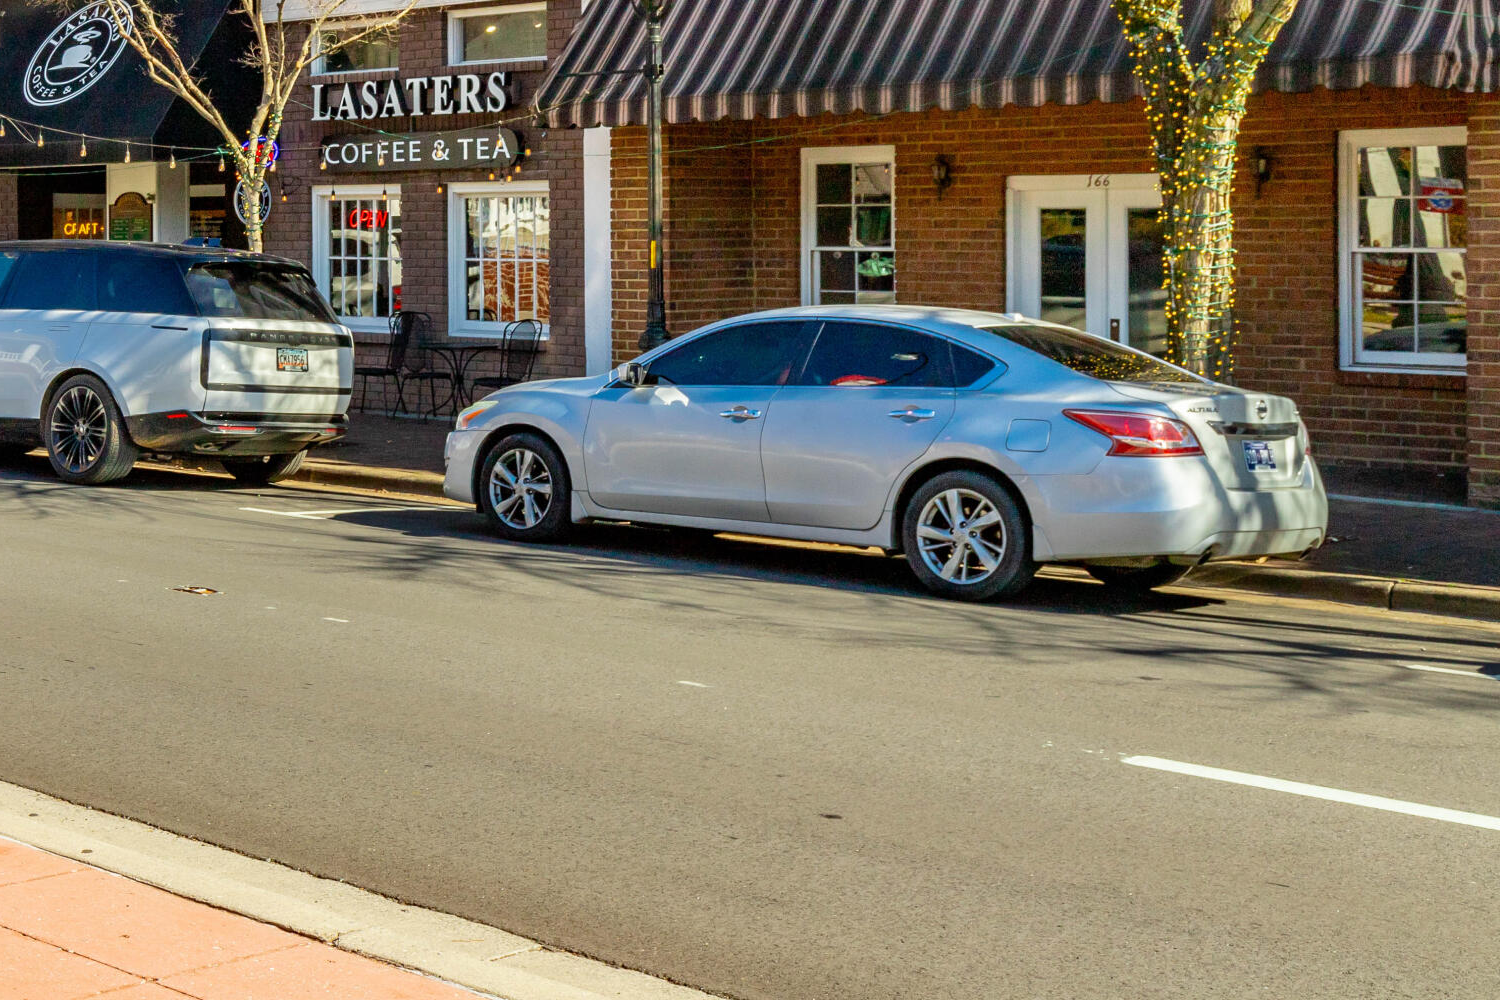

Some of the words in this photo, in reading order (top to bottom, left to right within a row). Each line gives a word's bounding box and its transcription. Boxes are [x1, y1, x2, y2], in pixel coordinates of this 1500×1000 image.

[32, 66, 57, 97] COFFEE
[62, 85, 72, 95] &
[79, 60, 108, 85] TEA
[311, 72, 506, 121] LASATERS
[325, 141, 421, 164] COFFEE
[431, 139, 449, 161] &
[457, 137, 511, 161] TEA
[1087, 174, 1110, 188] 166
[350, 208, 388, 229] OPEN
